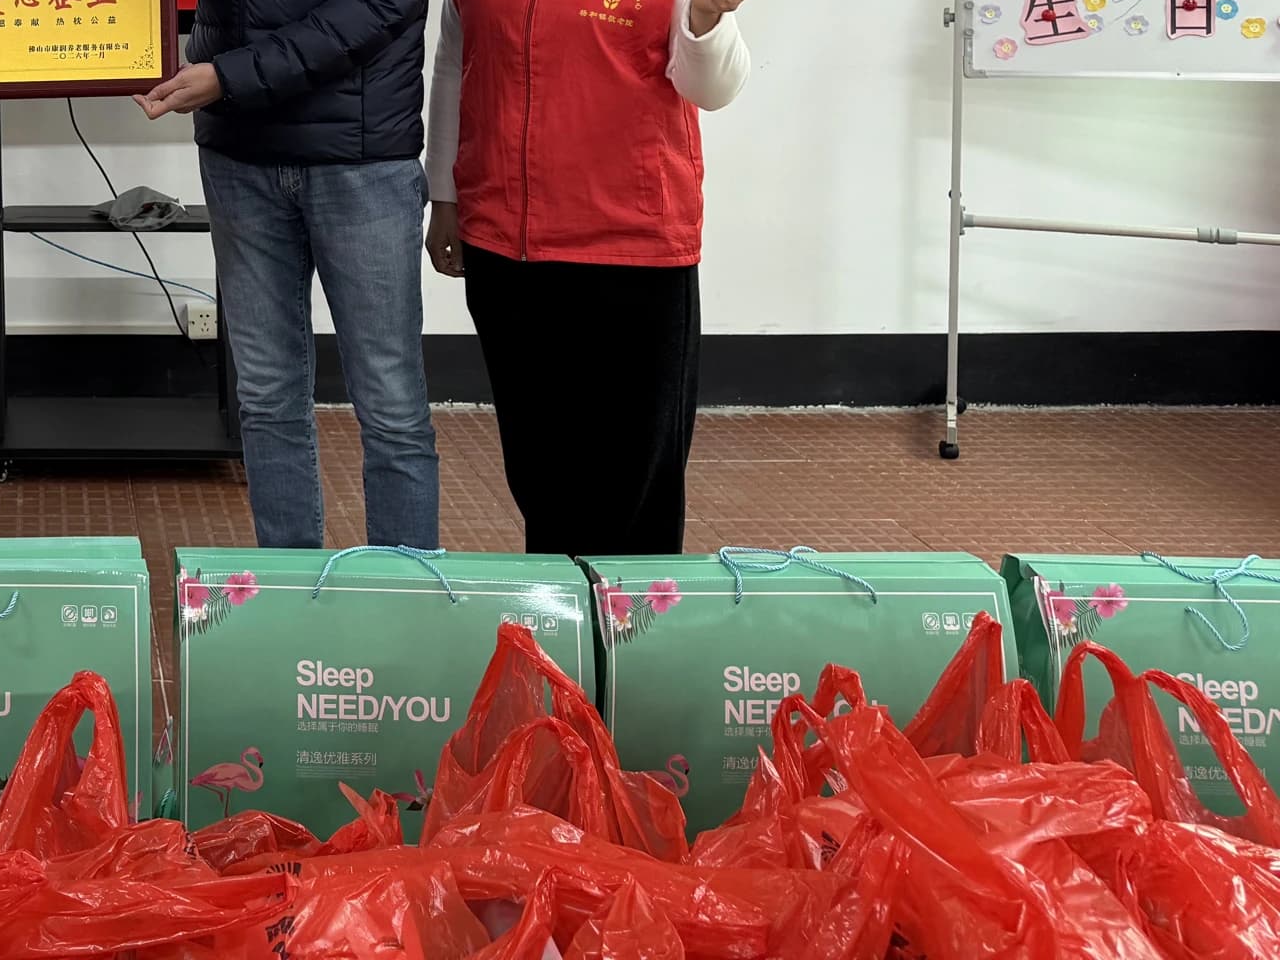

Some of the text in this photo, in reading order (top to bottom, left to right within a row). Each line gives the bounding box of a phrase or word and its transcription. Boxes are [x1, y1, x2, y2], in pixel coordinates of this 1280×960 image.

[296, 659, 374, 694] Sleep
[723, 666, 801, 698] Sleep
[297, 693, 451, 722] NEED/YOU
[297, 721, 379, 733] 选择属于你的睡眠
[296, 750, 377, 766] 清逸优雅系列
